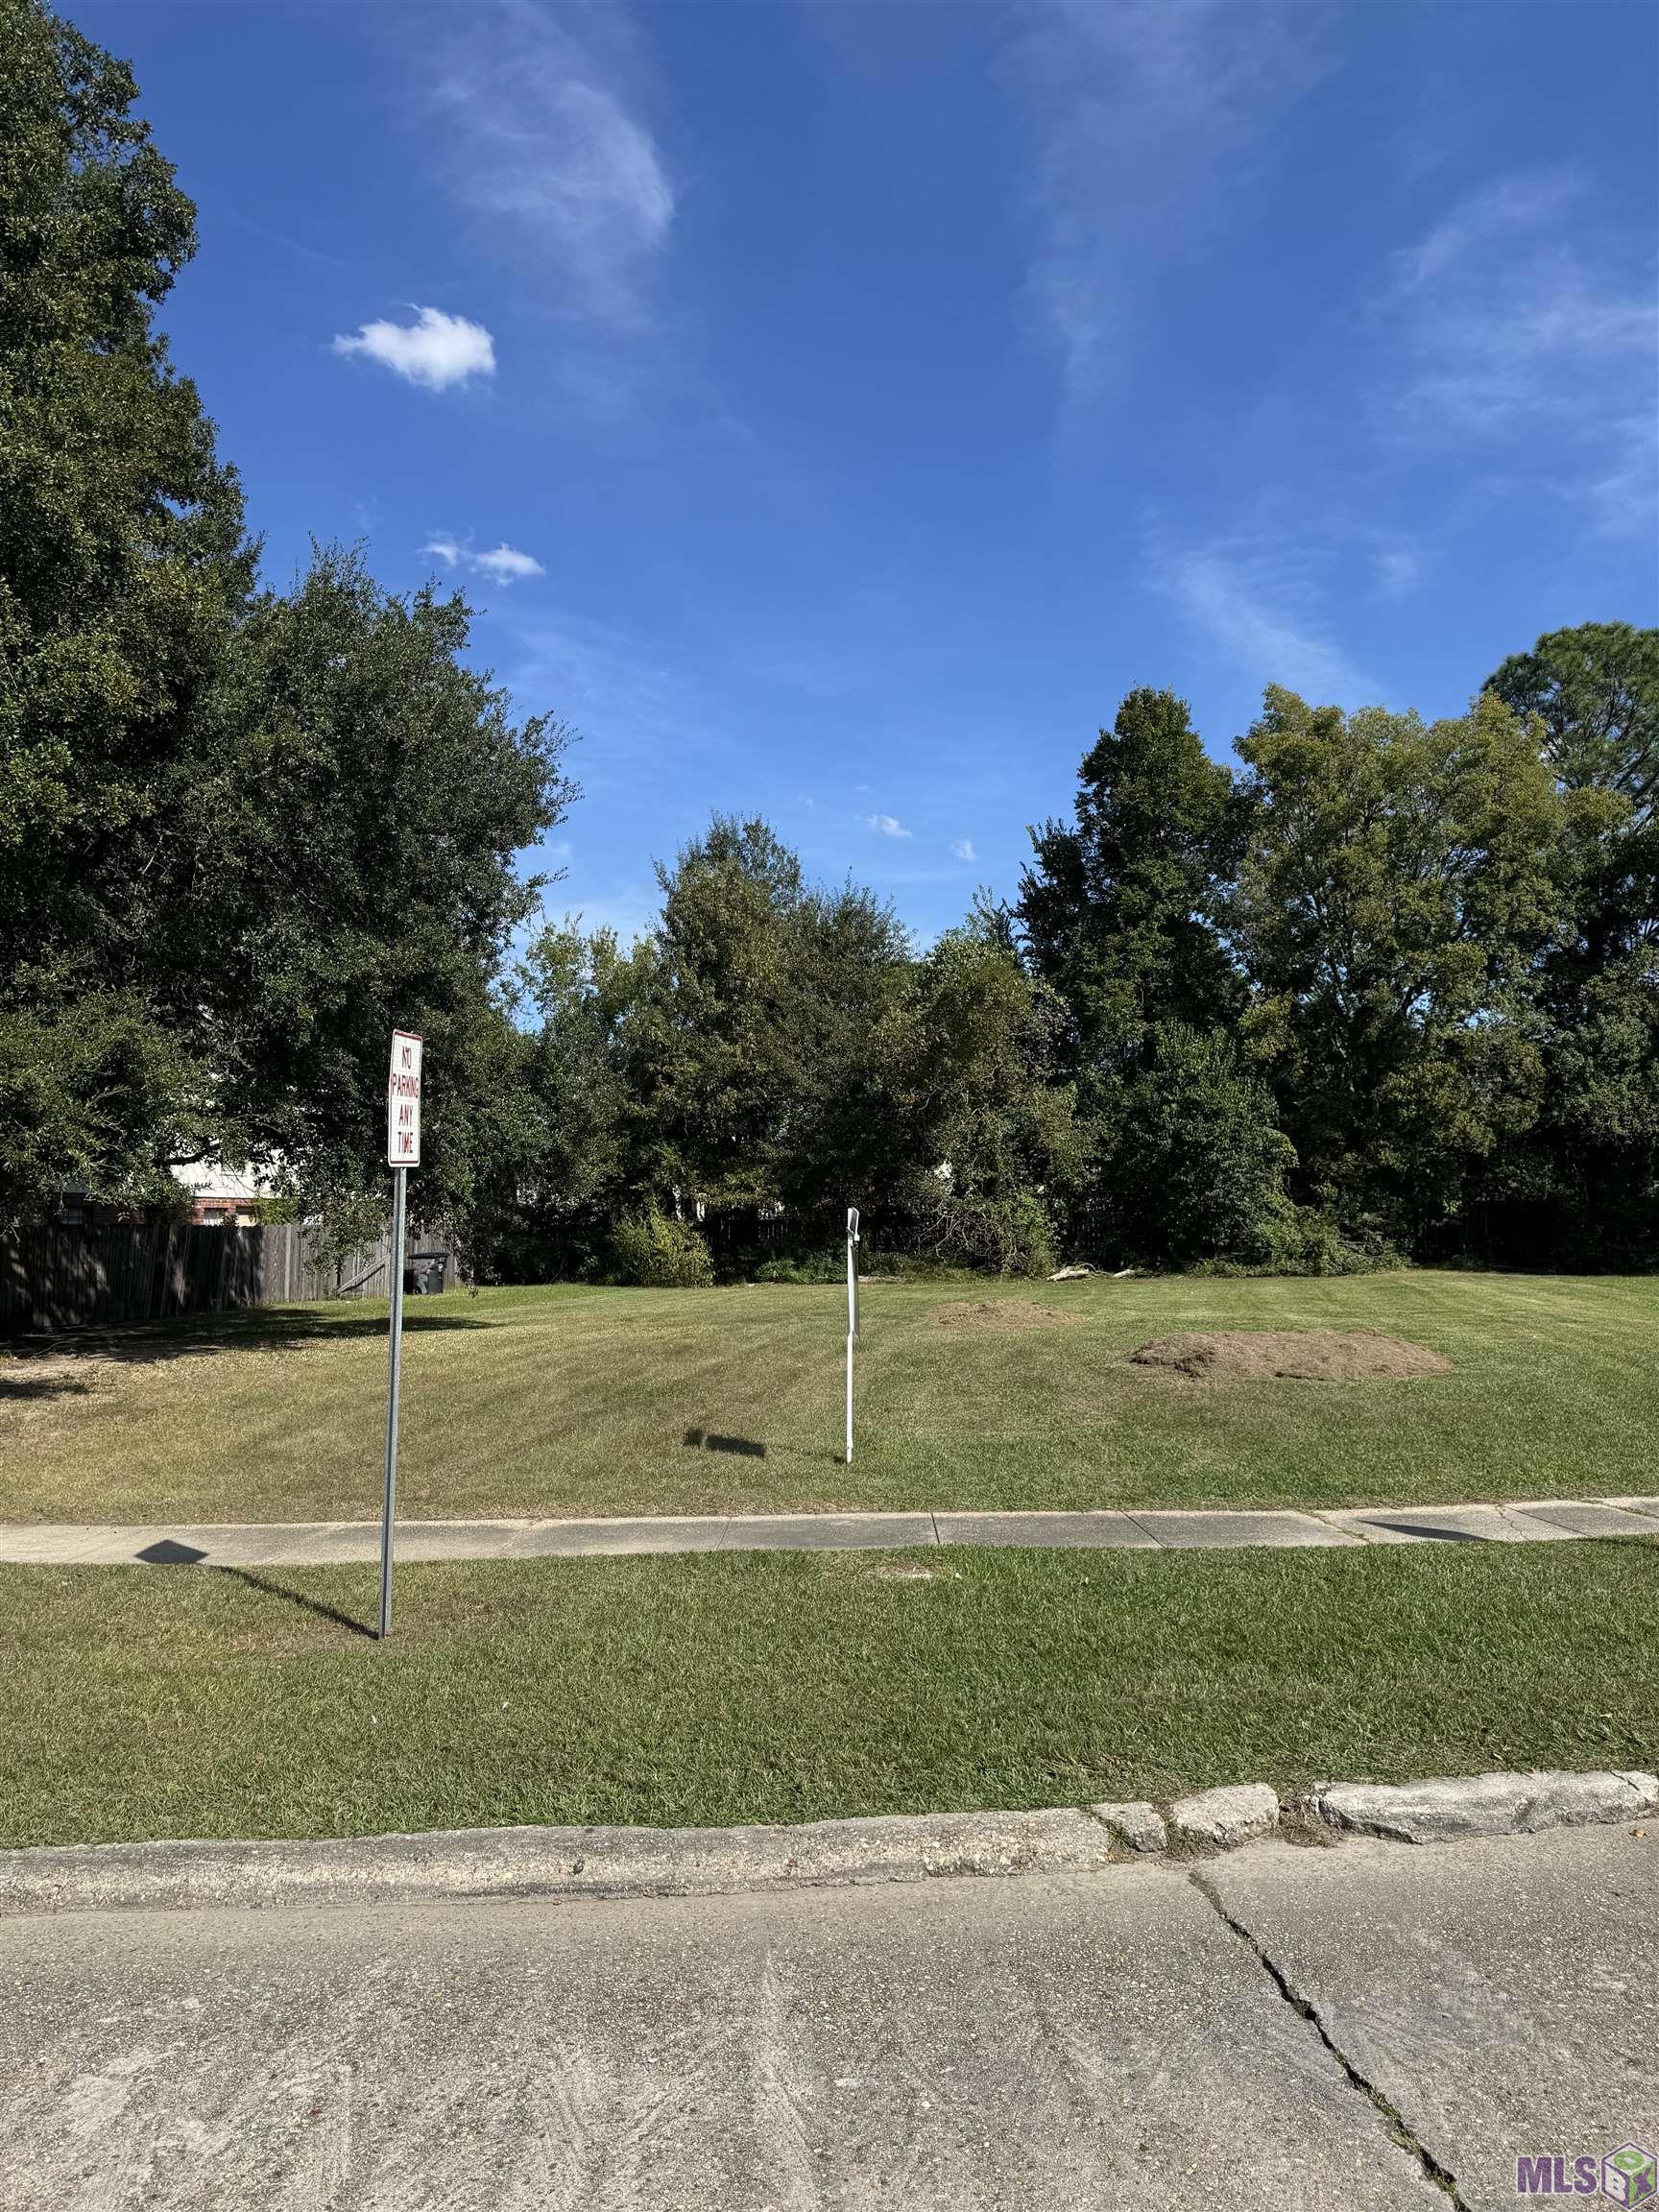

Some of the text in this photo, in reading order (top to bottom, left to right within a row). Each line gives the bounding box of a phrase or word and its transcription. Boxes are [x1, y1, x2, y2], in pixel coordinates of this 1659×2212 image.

[401, 1046, 412, 1069] NO
[393, 1073, 419, 1098] PARKING
[398, 1104, 413, 1126] ANY
[397, 1131, 414, 1153] TIME
